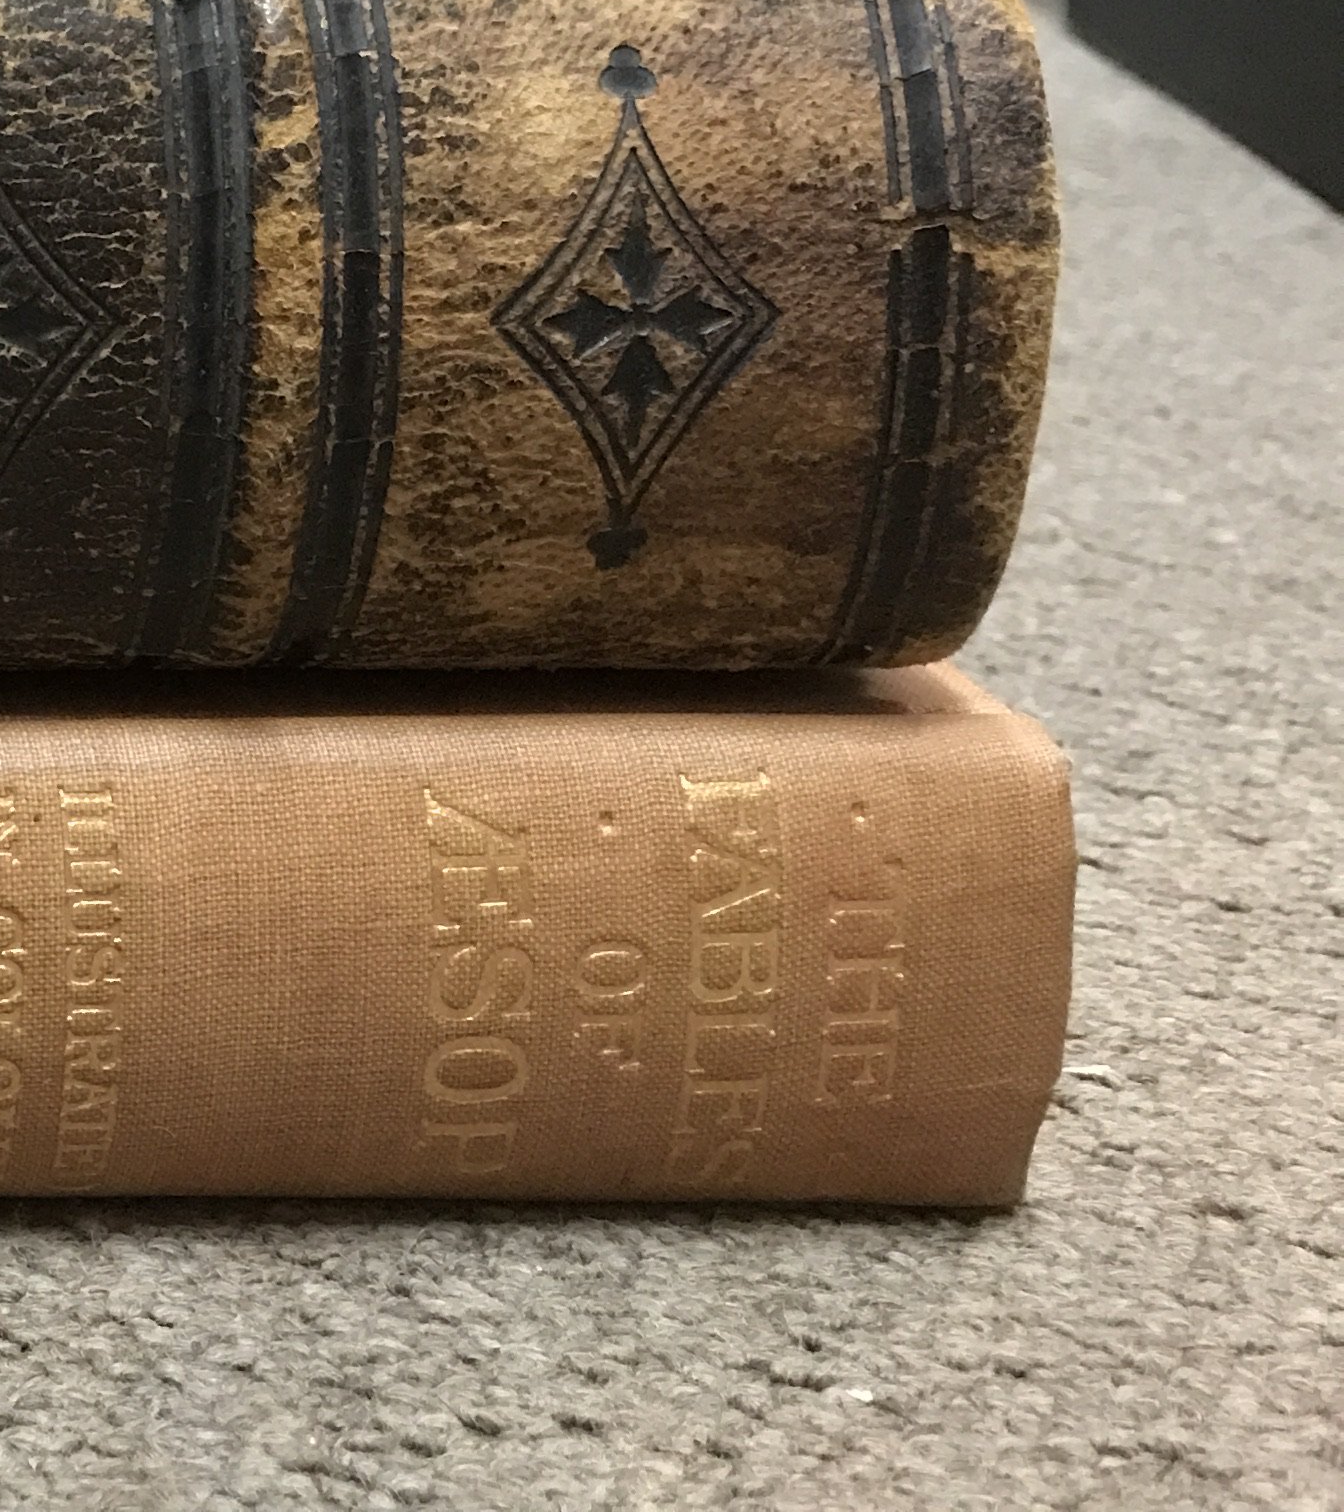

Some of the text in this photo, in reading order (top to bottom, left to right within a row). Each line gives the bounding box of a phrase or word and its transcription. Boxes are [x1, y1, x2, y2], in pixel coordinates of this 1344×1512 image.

[574, 941, 647, 1072] OF
[669, 768, 784, 1183] FABLES
[815, 859, 907, 1103] THE
